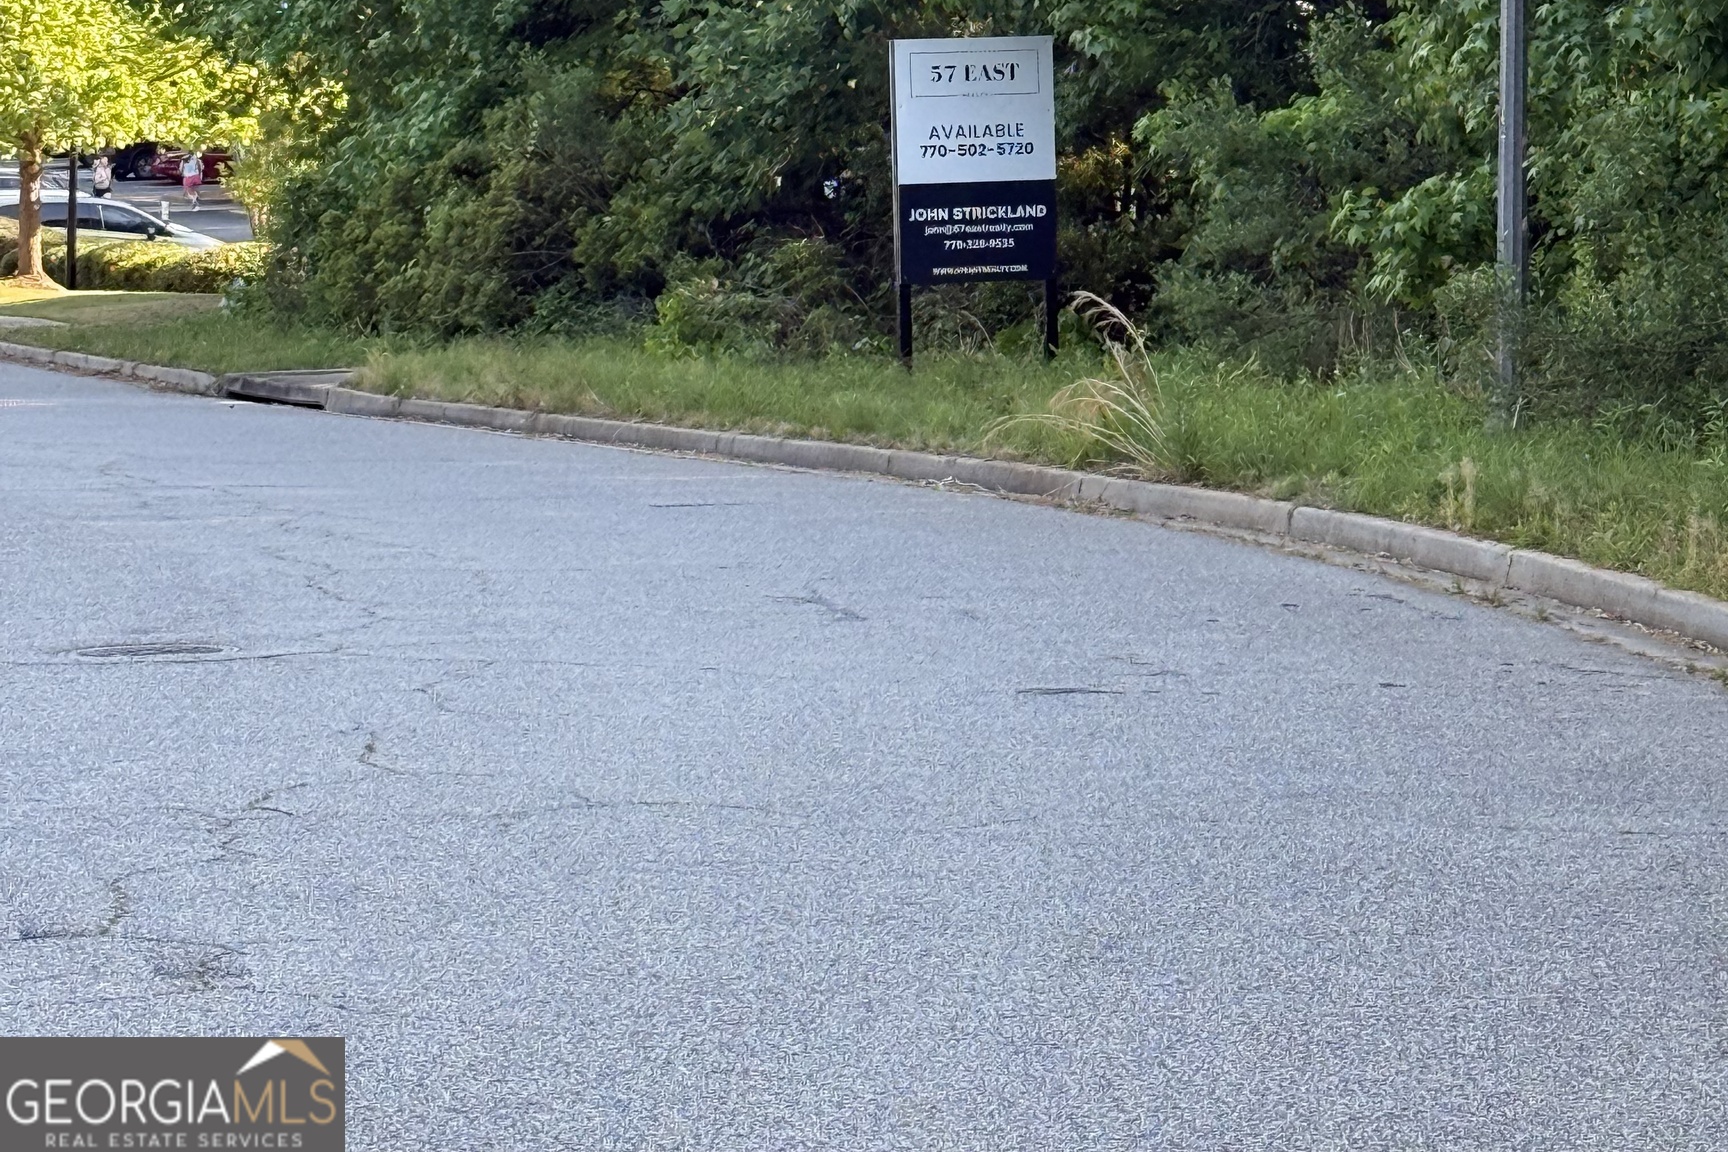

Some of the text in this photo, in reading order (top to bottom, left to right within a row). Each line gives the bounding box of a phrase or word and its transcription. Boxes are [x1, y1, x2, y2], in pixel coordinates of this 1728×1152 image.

[931, 63, 1019, 82] 57 EAST
[929, 123, 1024, 140] AVAILABLE
[920, 142, 1034, 158] 770-502-5720
[909, 205, 1047, 222] JOHN STRICKLAND
